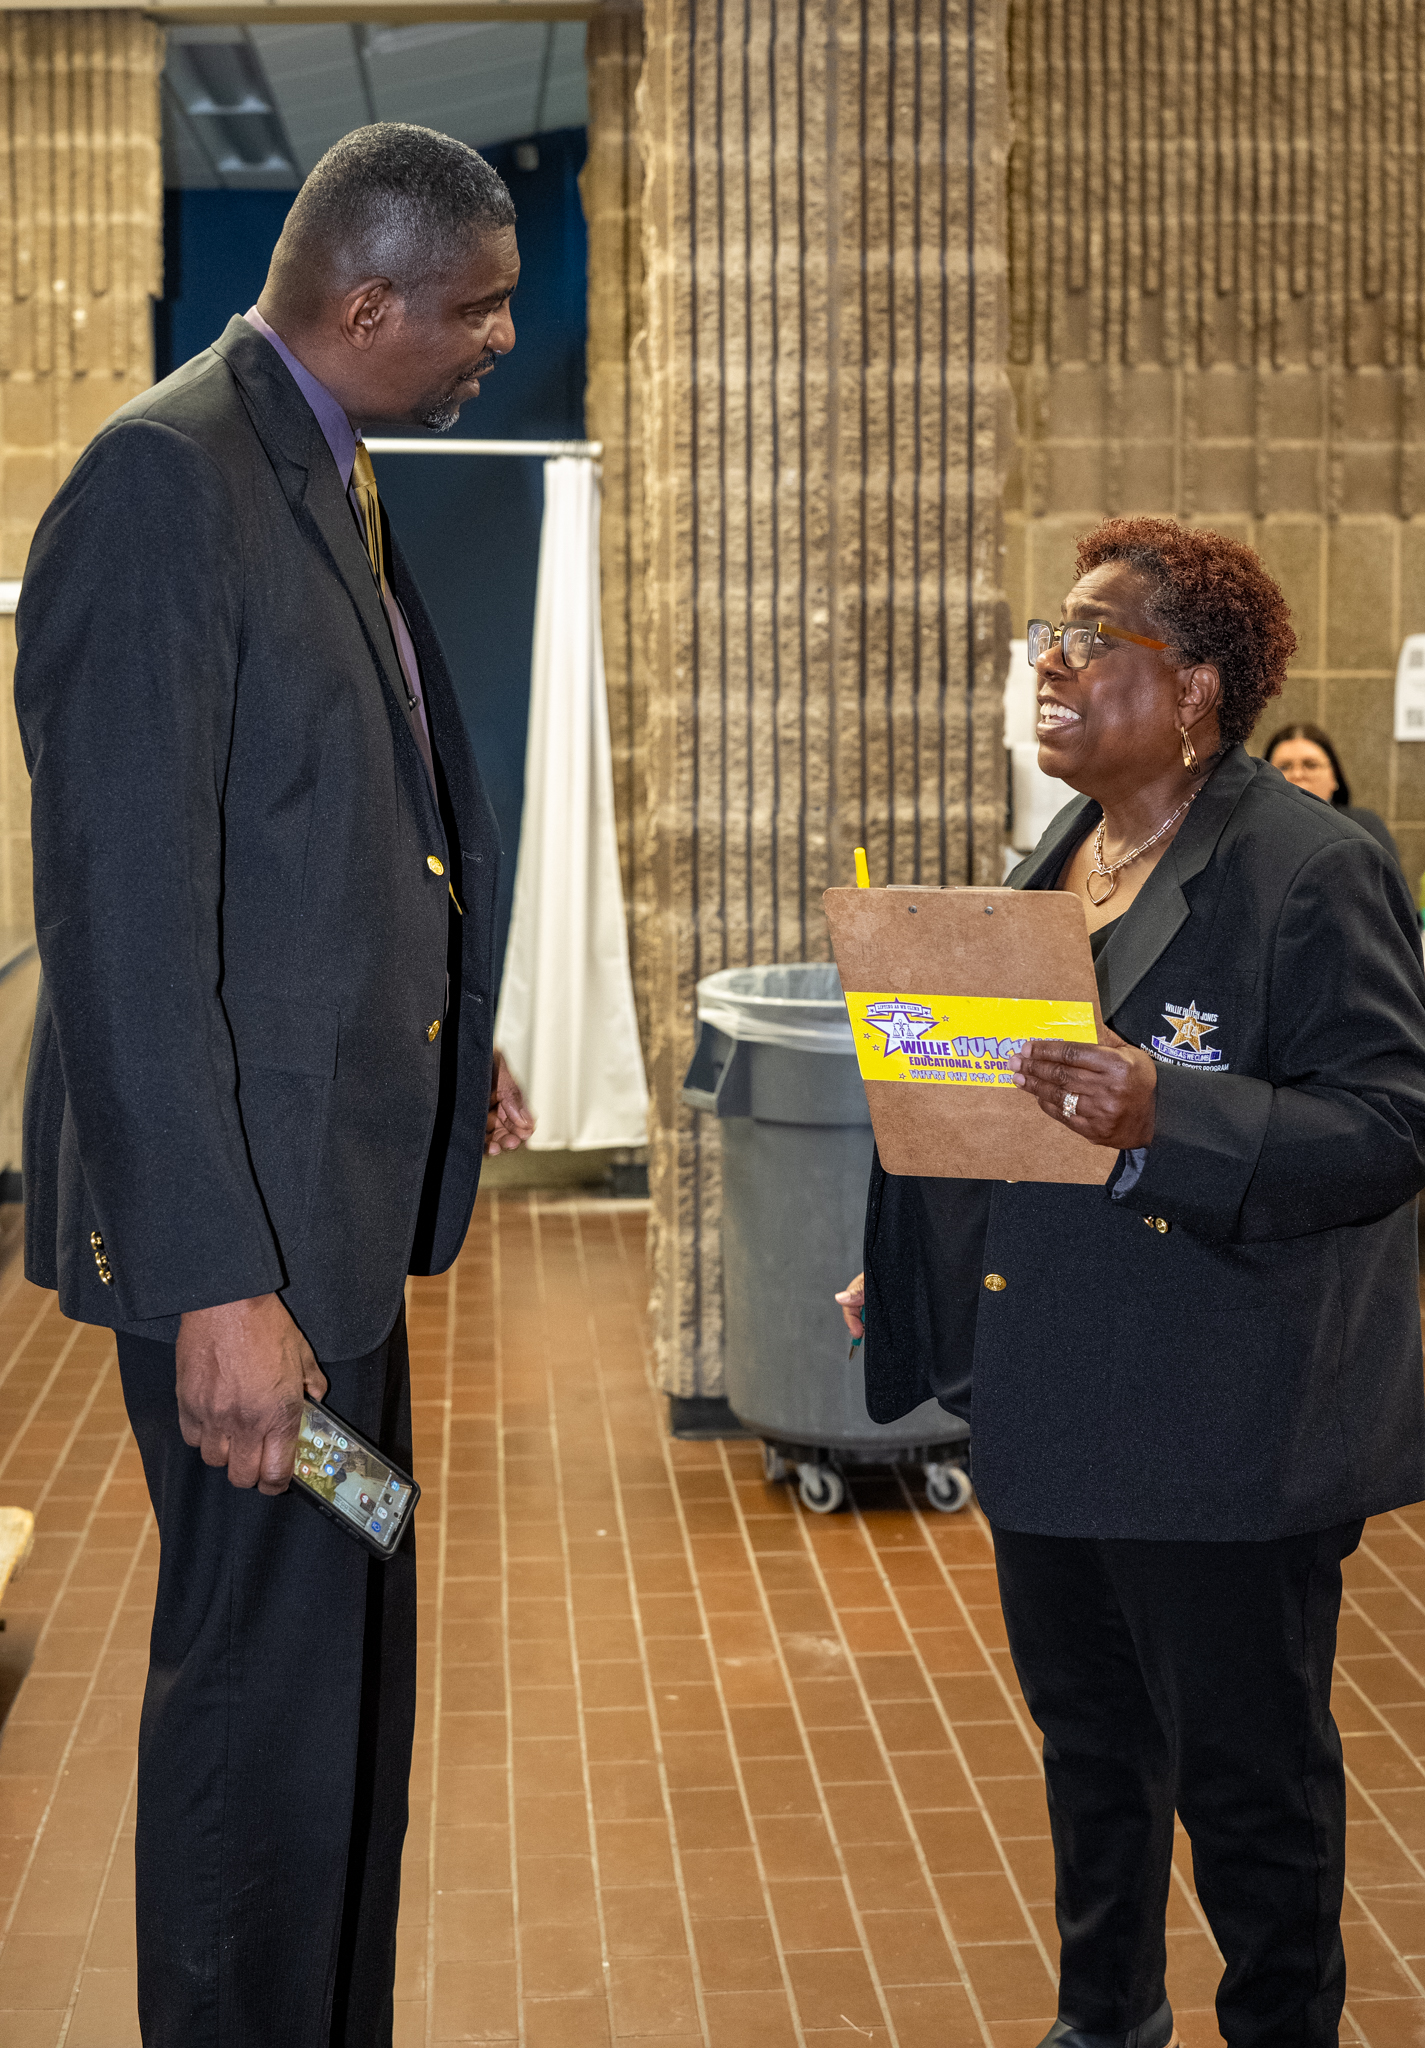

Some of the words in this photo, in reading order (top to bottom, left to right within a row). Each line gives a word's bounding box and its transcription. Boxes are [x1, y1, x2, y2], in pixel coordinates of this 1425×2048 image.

[1165, 1002, 1183, 1016] WILLIE
[1182, 1007, 1200, 1020] HUTCH
[1200, 1012, 1219, 1023] JONES
[899, 1040, 951, 1056] WILLIE
[908, 1056, 973, 1069] EDUCATIONAL
[974, 1061, 982, 1069] &
[983, 1060, 1010, 1071] SPOR
[908, 1069, 945, 1080] WHERE
[947, 1071, 967, 1081] THE
[969, 1072, 996, 1084] KIDS
[998, 1073, 1014, 1084] AR
